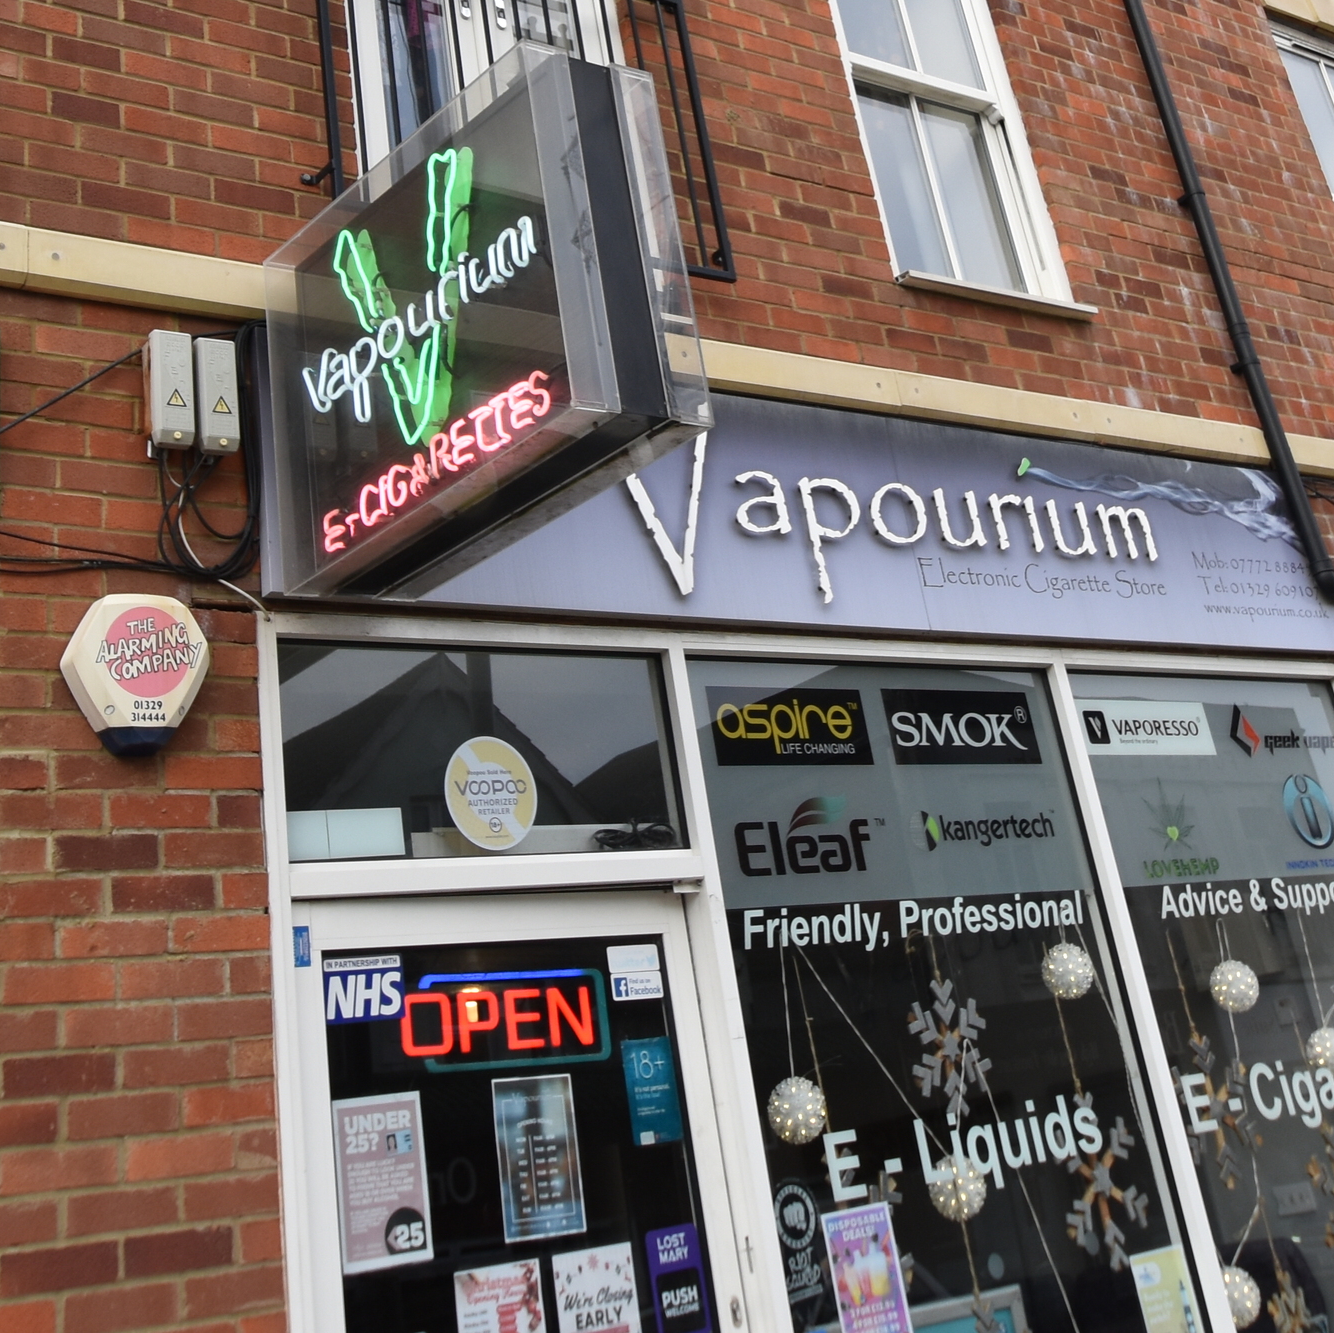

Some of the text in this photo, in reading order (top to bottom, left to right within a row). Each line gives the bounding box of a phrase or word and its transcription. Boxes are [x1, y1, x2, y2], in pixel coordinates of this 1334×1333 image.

[323, 370, 552, 553] E-CIGARETTES
[625, 403, 1159, 604] Vapourium
[917, 556, 1167, 600] Electronic Cigarette Store
[126, 617, 156, 635] THE
[96, 621, 189, 664] ALARMING
[109, 641, 203, 681] COMPANY
[131, 712, 166, 722] 314444
[133, 700, 163, 710] 01329
[717, 699, 853, 755] aspire
[890, 711, 1028, 751] SMOK
[1111, 718, 1199, 737] VAPORESSO
[781, 742, 856, 755] LIFE CHANGING
[468, 798, 518, 807] AUTHORIZED
[939, 813, 1056, 847] kangertech
[734, 818, 871, 877] Eleaf
[1161, 881, 1243, 920] Advice
[1249, 878, 1268, 912] &
[743, 890, 1084, 952] Friendly, Professional
[325, 956, 398, 969] IN PARTNERSHIP WITH
[327, 971, 402, 1021] NHS
[630, 985, 662, 996] Facebook
[400, 986, 595, 1057] OPEN
[630, 1050, 665, 1079] 18+
[1184, 1072, 1219, 1135] E
[343, 1110, 411, 1135] UNDER
[345, 1132, 380, 1155] 25?
[822, 1128, 866, 1202] E
[913, 1095, 1104, 1190] Liquids
[395, 1221, 425, 1250] 25
[656, 1232, 685, 1252] LOST
[659, 1245, 689, 1265] MARY
[661, 1285, 699, 1309] PUSH
[575, 1306, 623, 1331] EARLY
